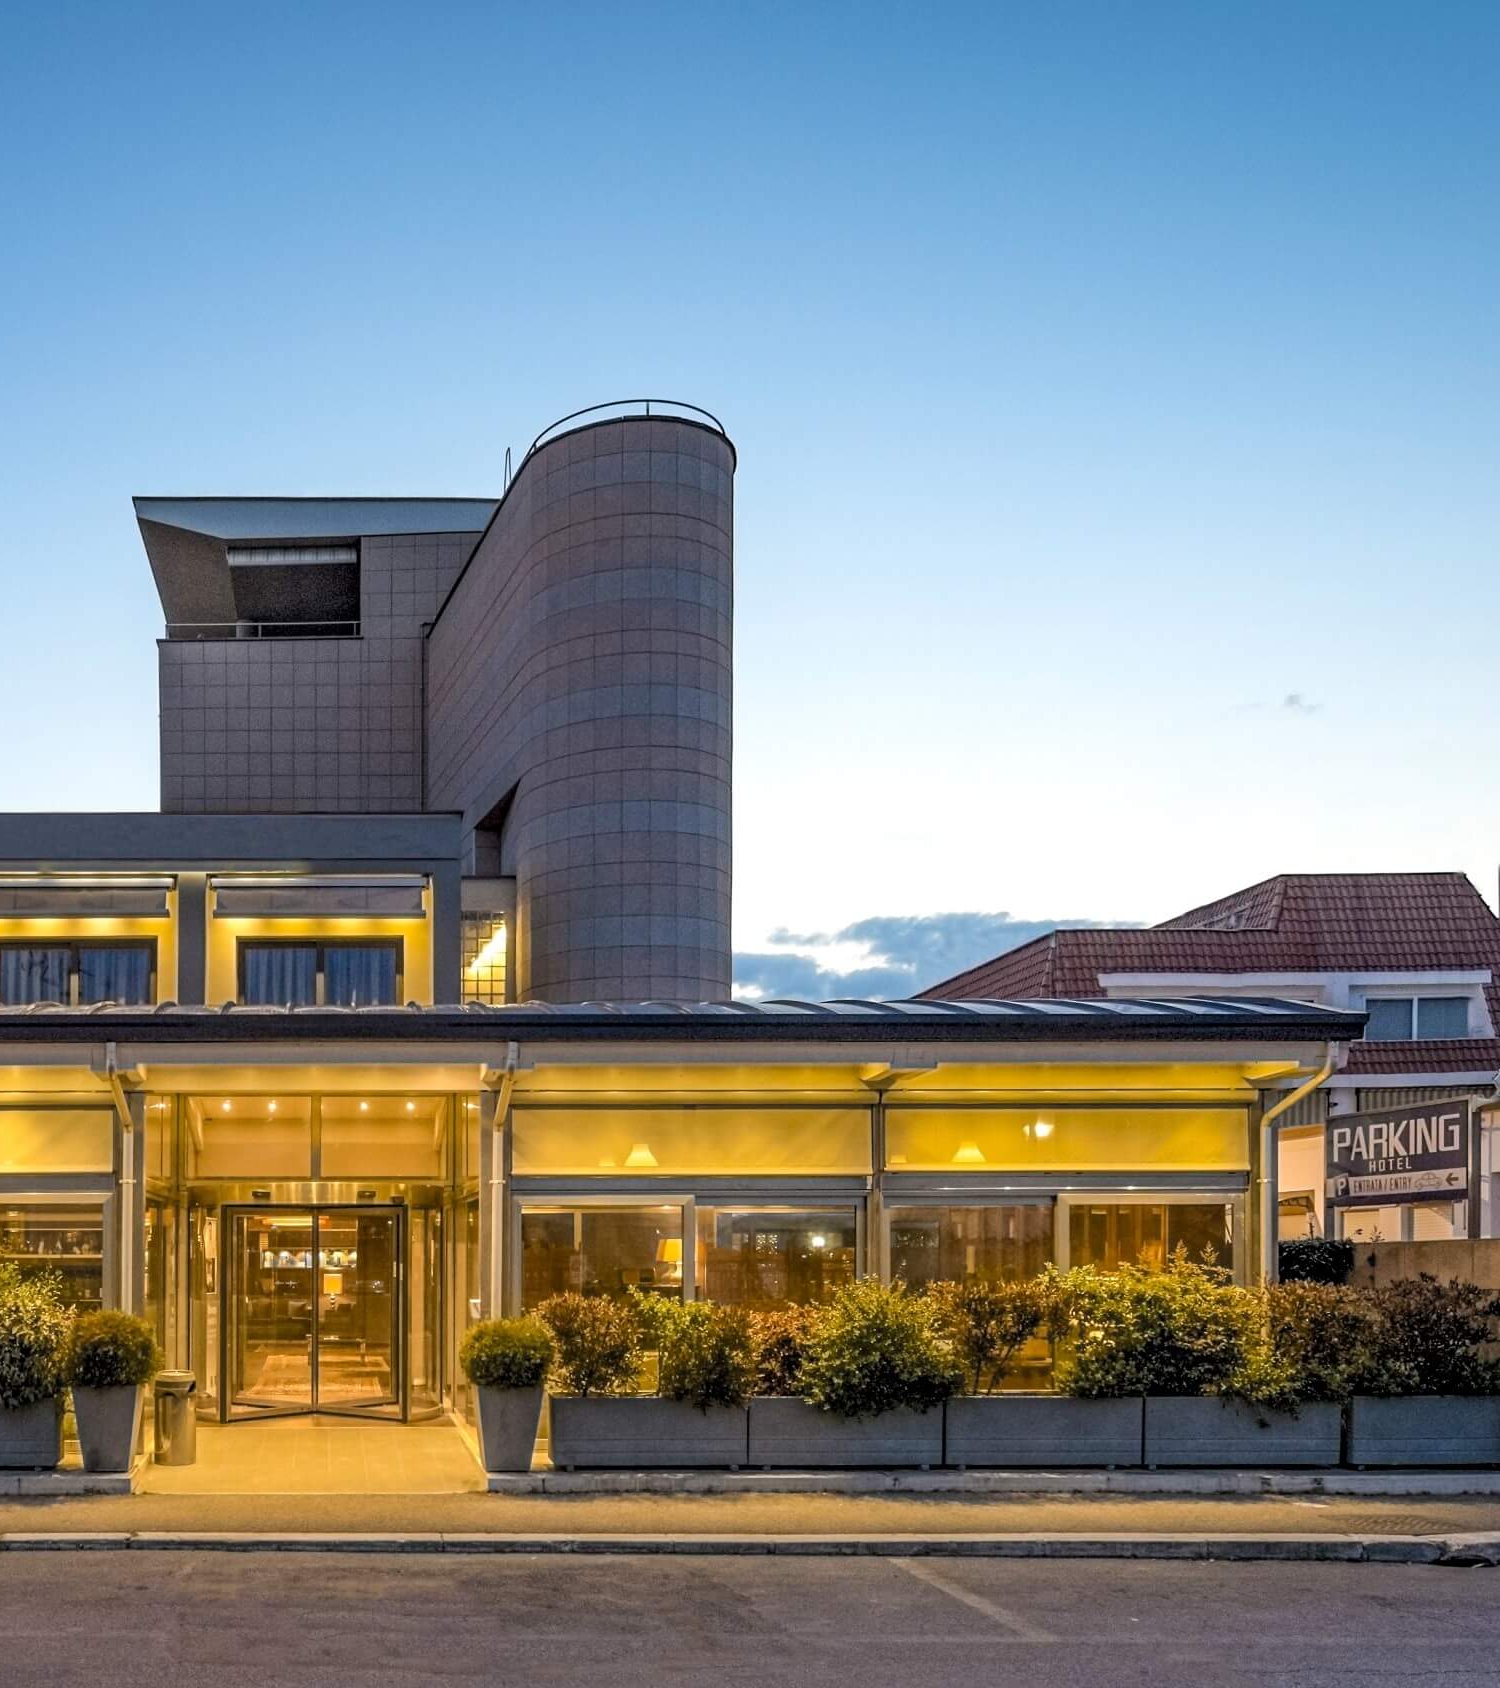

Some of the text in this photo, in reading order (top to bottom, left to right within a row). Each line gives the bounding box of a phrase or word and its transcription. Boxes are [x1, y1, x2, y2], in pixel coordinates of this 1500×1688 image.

[1333, 1113, 1460, 1162] PARKING
[1369, 1157, 1412, 1172] HOTEL
[1337, 1178, 1346, 1196] P
[1353, 1178, 1382, 1193] ENTRATA
[1389, 1177, 1412, 1191] ENTRY
